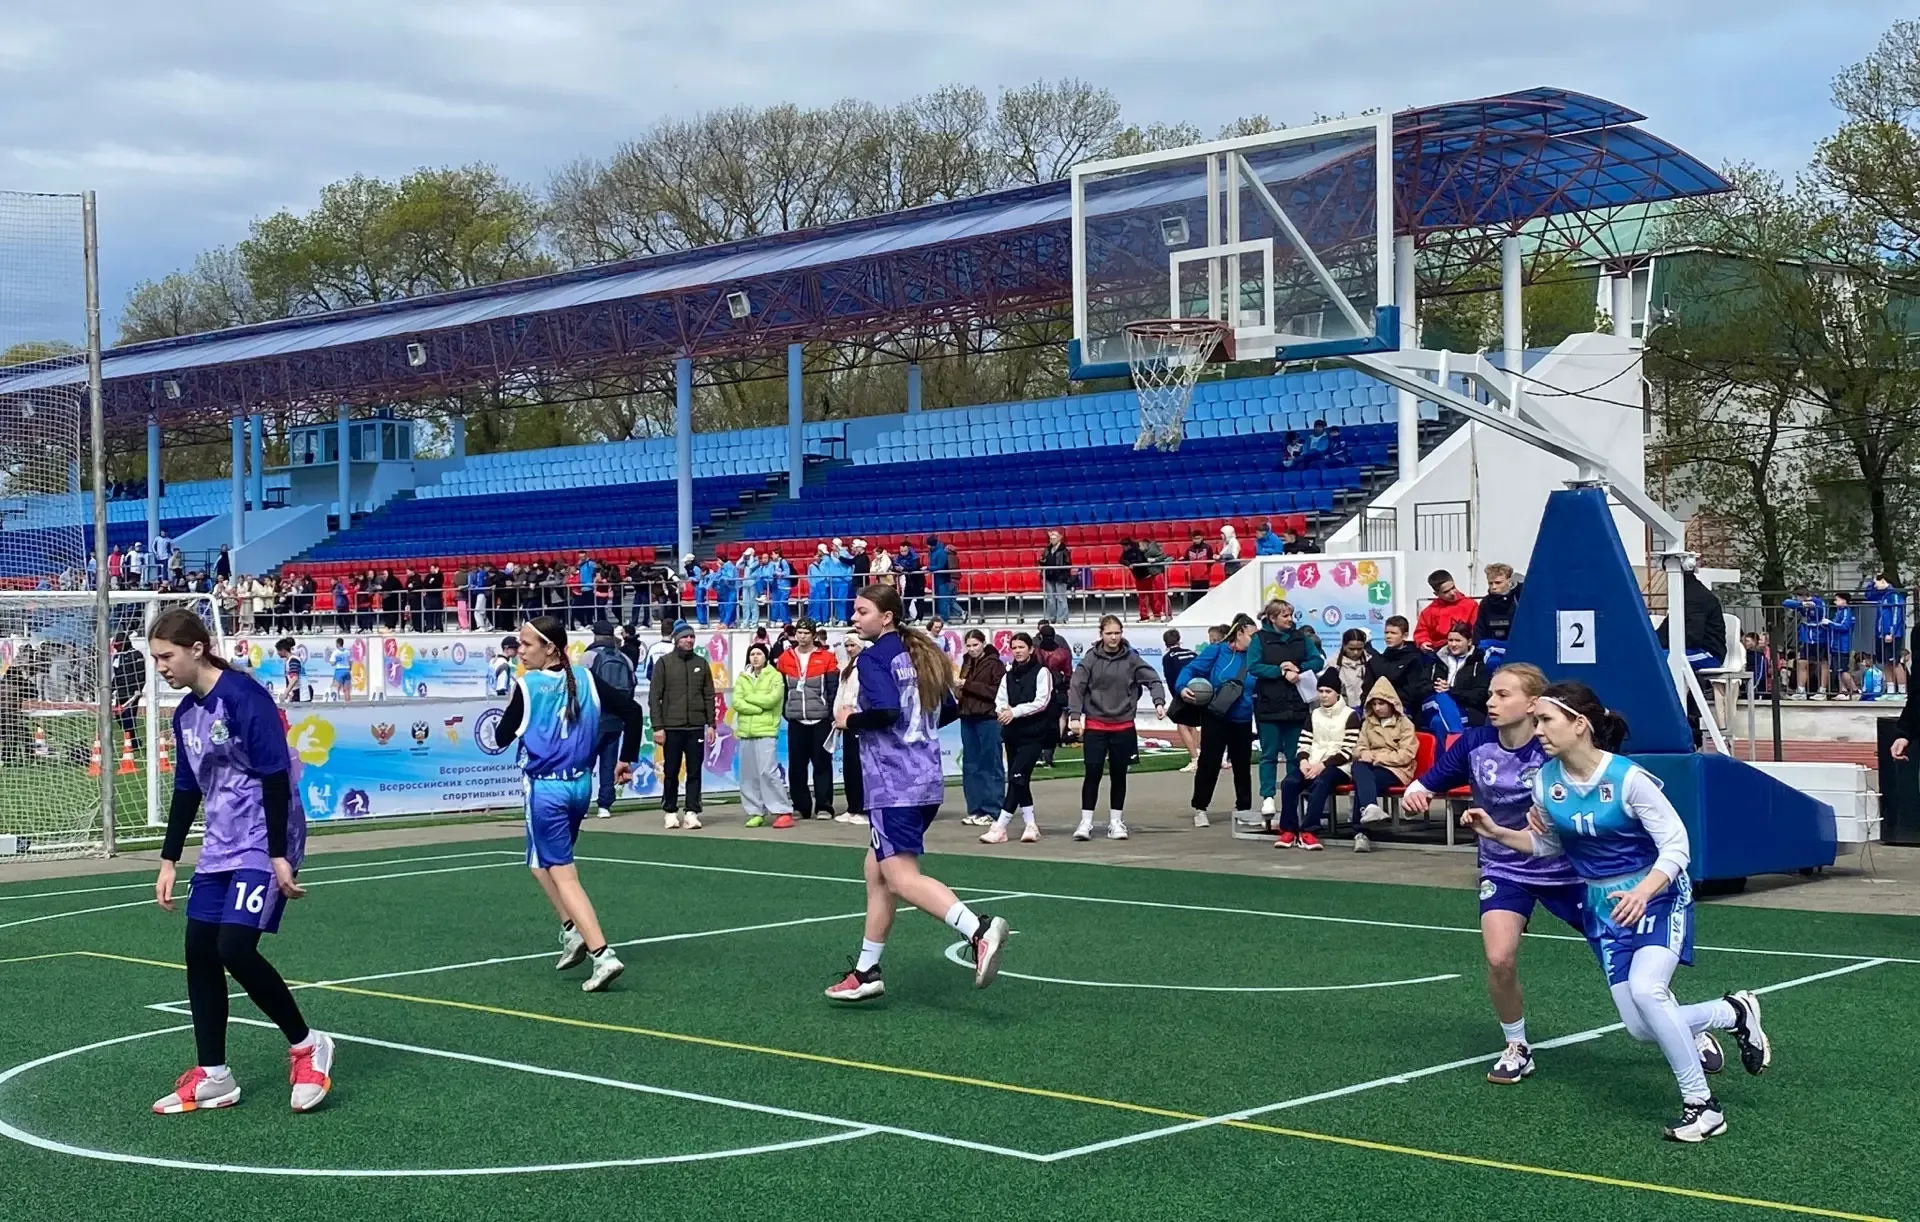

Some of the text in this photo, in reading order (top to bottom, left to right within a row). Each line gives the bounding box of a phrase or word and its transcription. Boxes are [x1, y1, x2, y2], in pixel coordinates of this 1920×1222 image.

[1569, 622, 1585, 648] 2
[465, 776, 524, 787] спортивны
[1570, 811, 1598, 837] 11
[235, 882, 265, 914] 16
